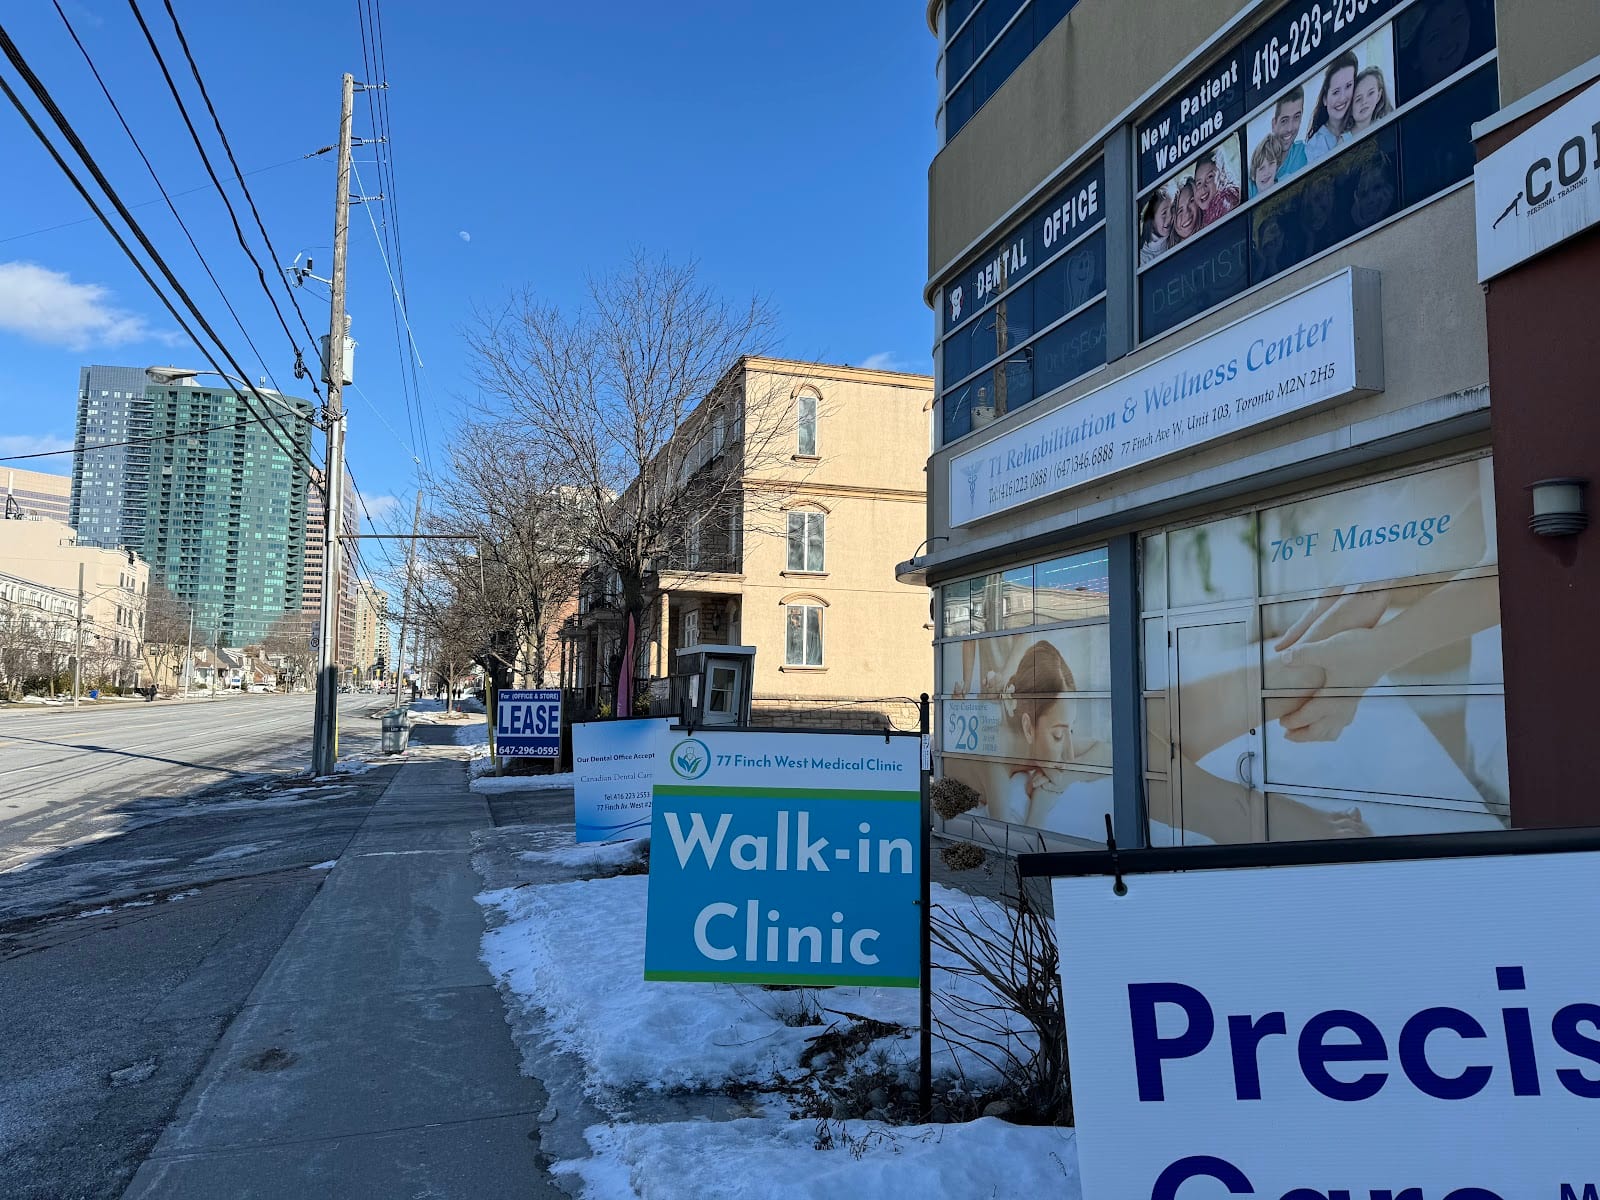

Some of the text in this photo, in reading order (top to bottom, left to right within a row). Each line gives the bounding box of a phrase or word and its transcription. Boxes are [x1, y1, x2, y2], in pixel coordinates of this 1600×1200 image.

[1252, 0, 1379, 90] 416-223-25
[1141, 117, 1170, 154] New
[1180, 60, 1239, 124] Patient
[1155, 110, 1223, 173] Welcome
[1526, 177, 1588, 217] PERSONAL TRAINING
[977, 180, 1098, 299] DENTAL OFFICE
[1006, 411, 1116, 471] Rehabilitation
[1122, 397, 1138, 424] &
[1144, 359, 1238, 414] Wellness
[1246, 316, 1333, 372] Center
[1121, 442, 1131, 457] 77
[1132, 435, 1154, 452] Finch
[1155, 429, 1170, 444] Ave
[1187, 410, 1209, 431] Unit
[1212, 403, 1231, 421] 103,
[1235, 389, 1275, 414] Toronto
[1277, 373, 1307, 395] M2N
[1310, 362, 1336, 386] 2H5
[1271, 514, 1451, 563] 76°F Massage
[500, 704, 559, 735] LEASE
[540, 692, 559, 700] STORE)
[499, 746, 559, 756] 647-296-0595
[949, 712, 979, 751] $28
[580, 775, 612, 783] Canadian
[614, 773, 636, 781] Dental
[633, 752, 655, 761] Accept
[716, 754, 903, 772] 77 Finch West Medical Clinic
[604, 803, 620, 811] Finch
[664, 810, 913, 874] Walk-in
[694, 899, 880, 965] Clinic
[1128, 965, 1600, 1102] Precis
